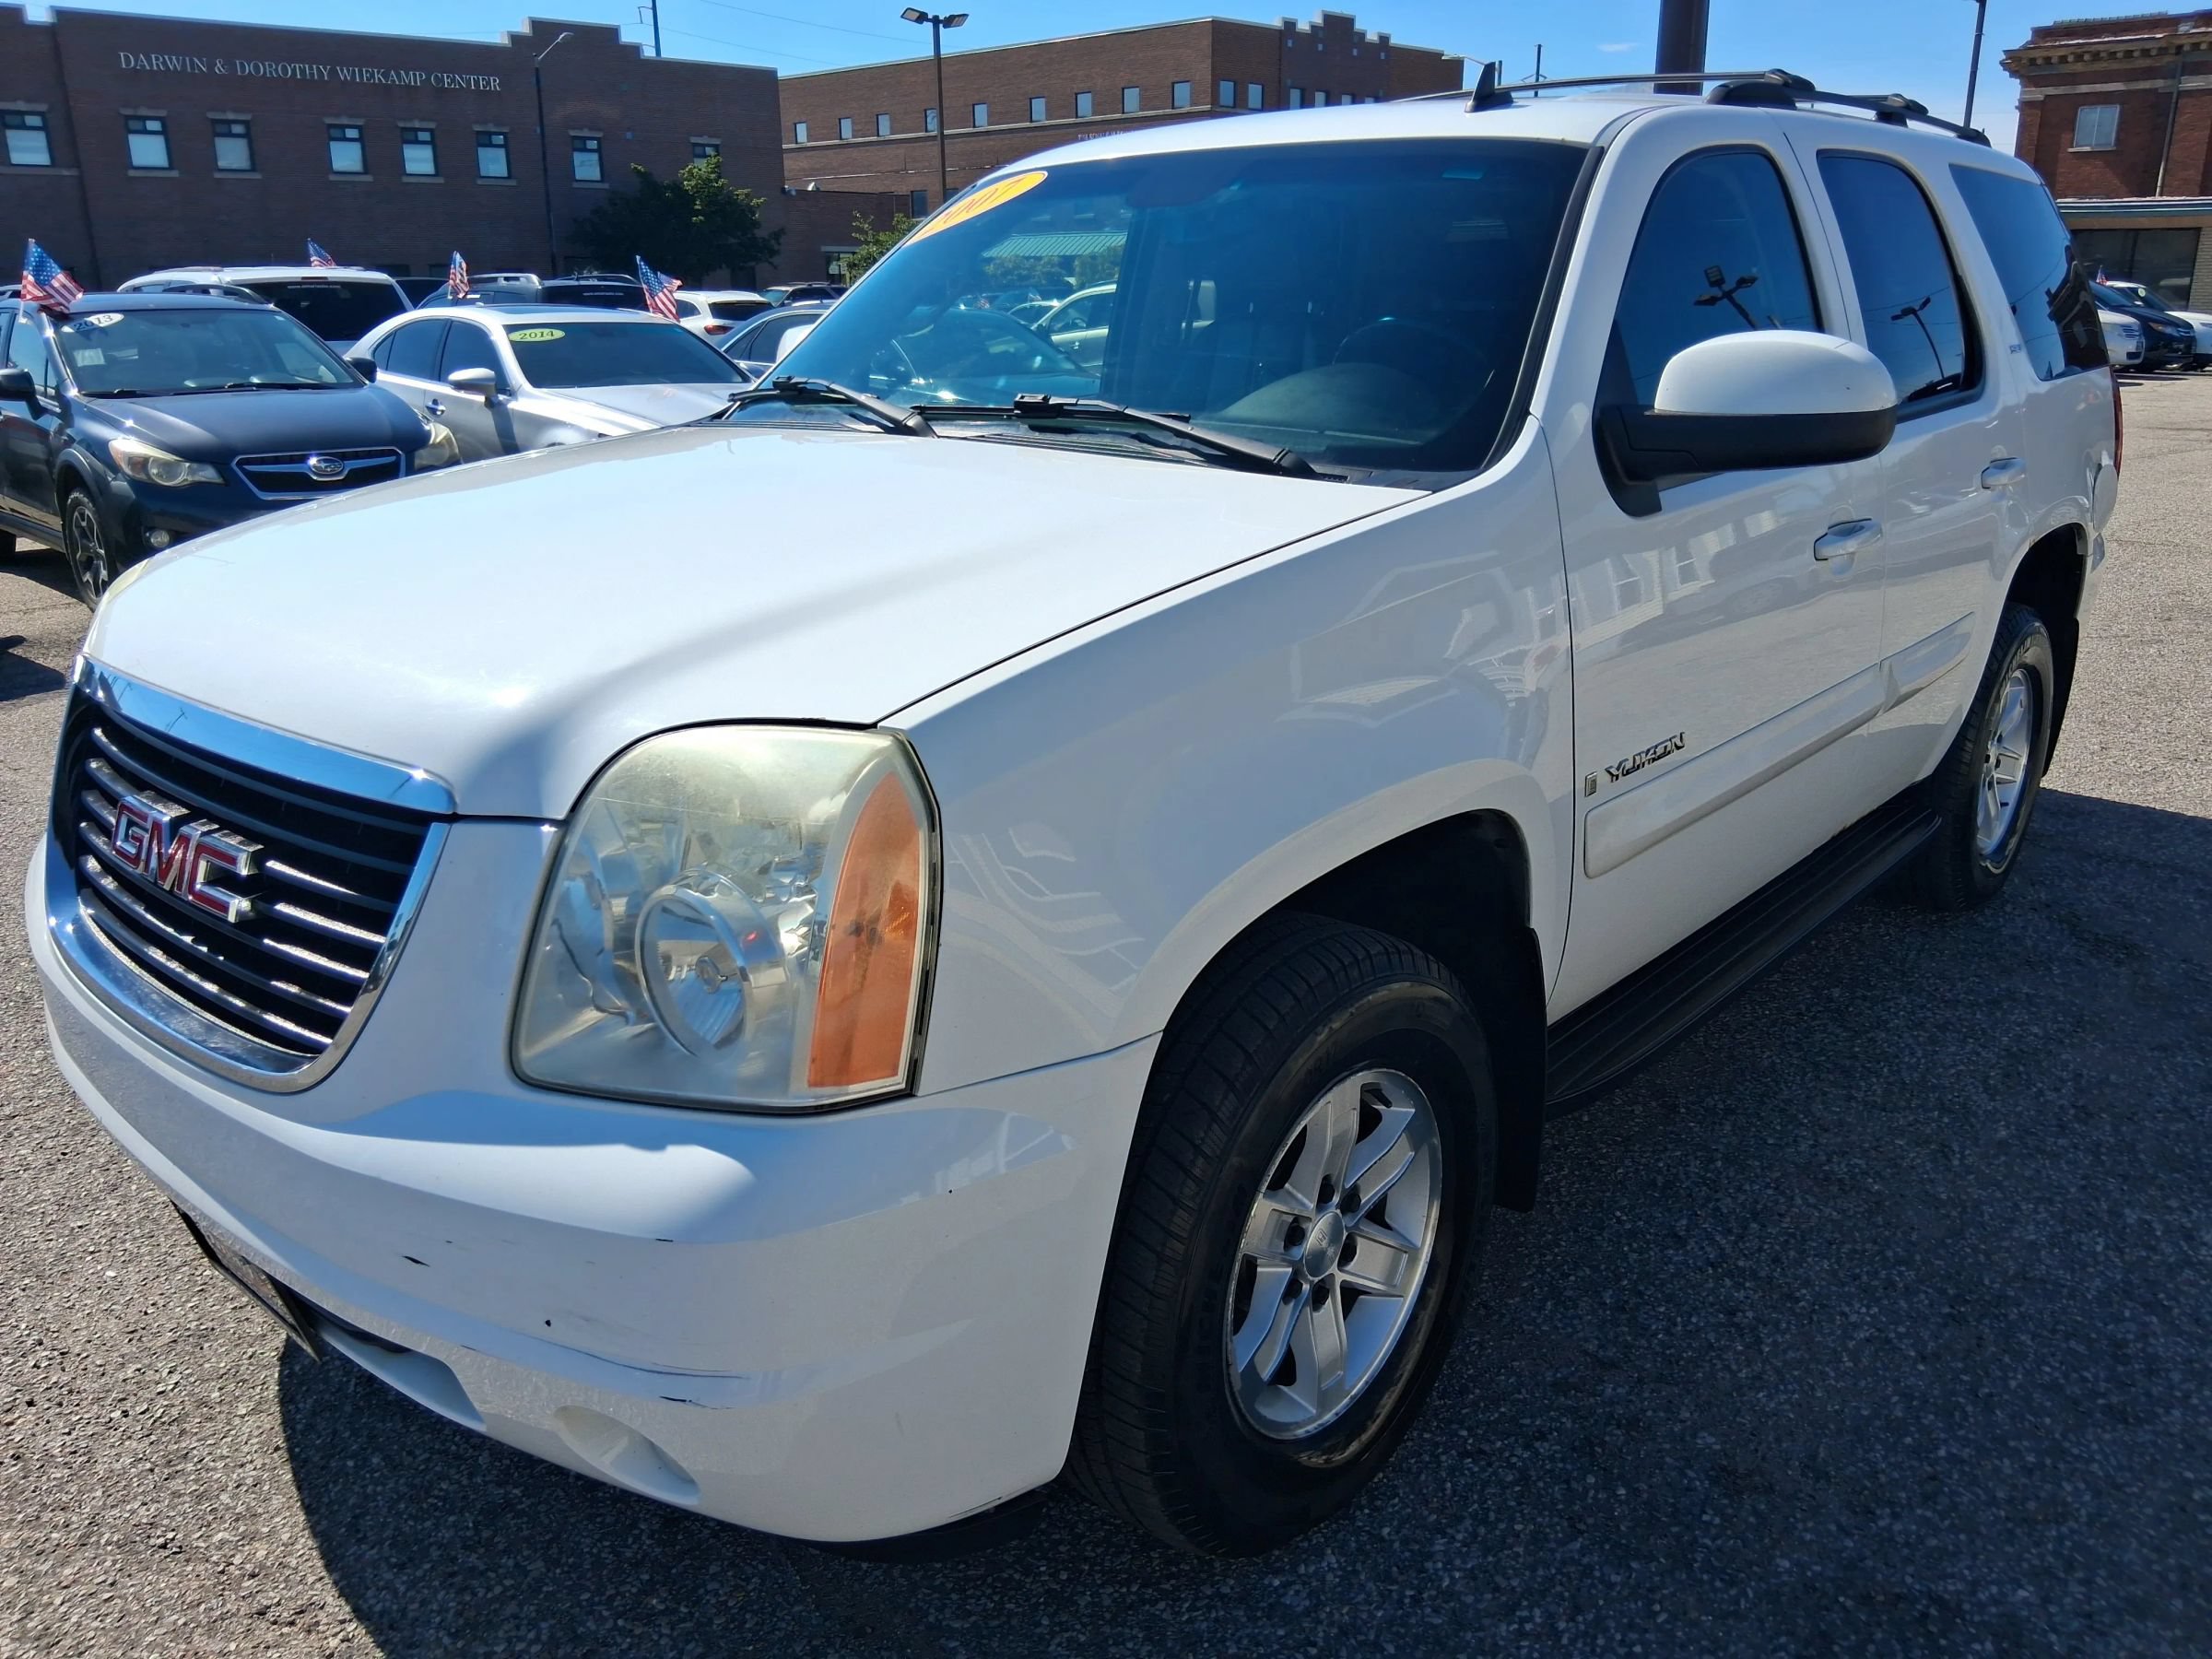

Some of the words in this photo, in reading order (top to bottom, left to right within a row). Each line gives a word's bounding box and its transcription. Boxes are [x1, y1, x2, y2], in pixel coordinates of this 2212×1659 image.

[118, 52, 207, 74] DARWIN
[214, 58, 229, 75] &
[235, 59, 332, 81] DOROTHY
[336, 65, 426, 87] WIEKAMP
[430, 72, 501, 91] CENTER
[74, 314, 113, 331] 2013
[518, 330, 555, 340] 2014
[1605, 731, 1686, 783] YUKON
[112, 794, 258, 924] GMC
